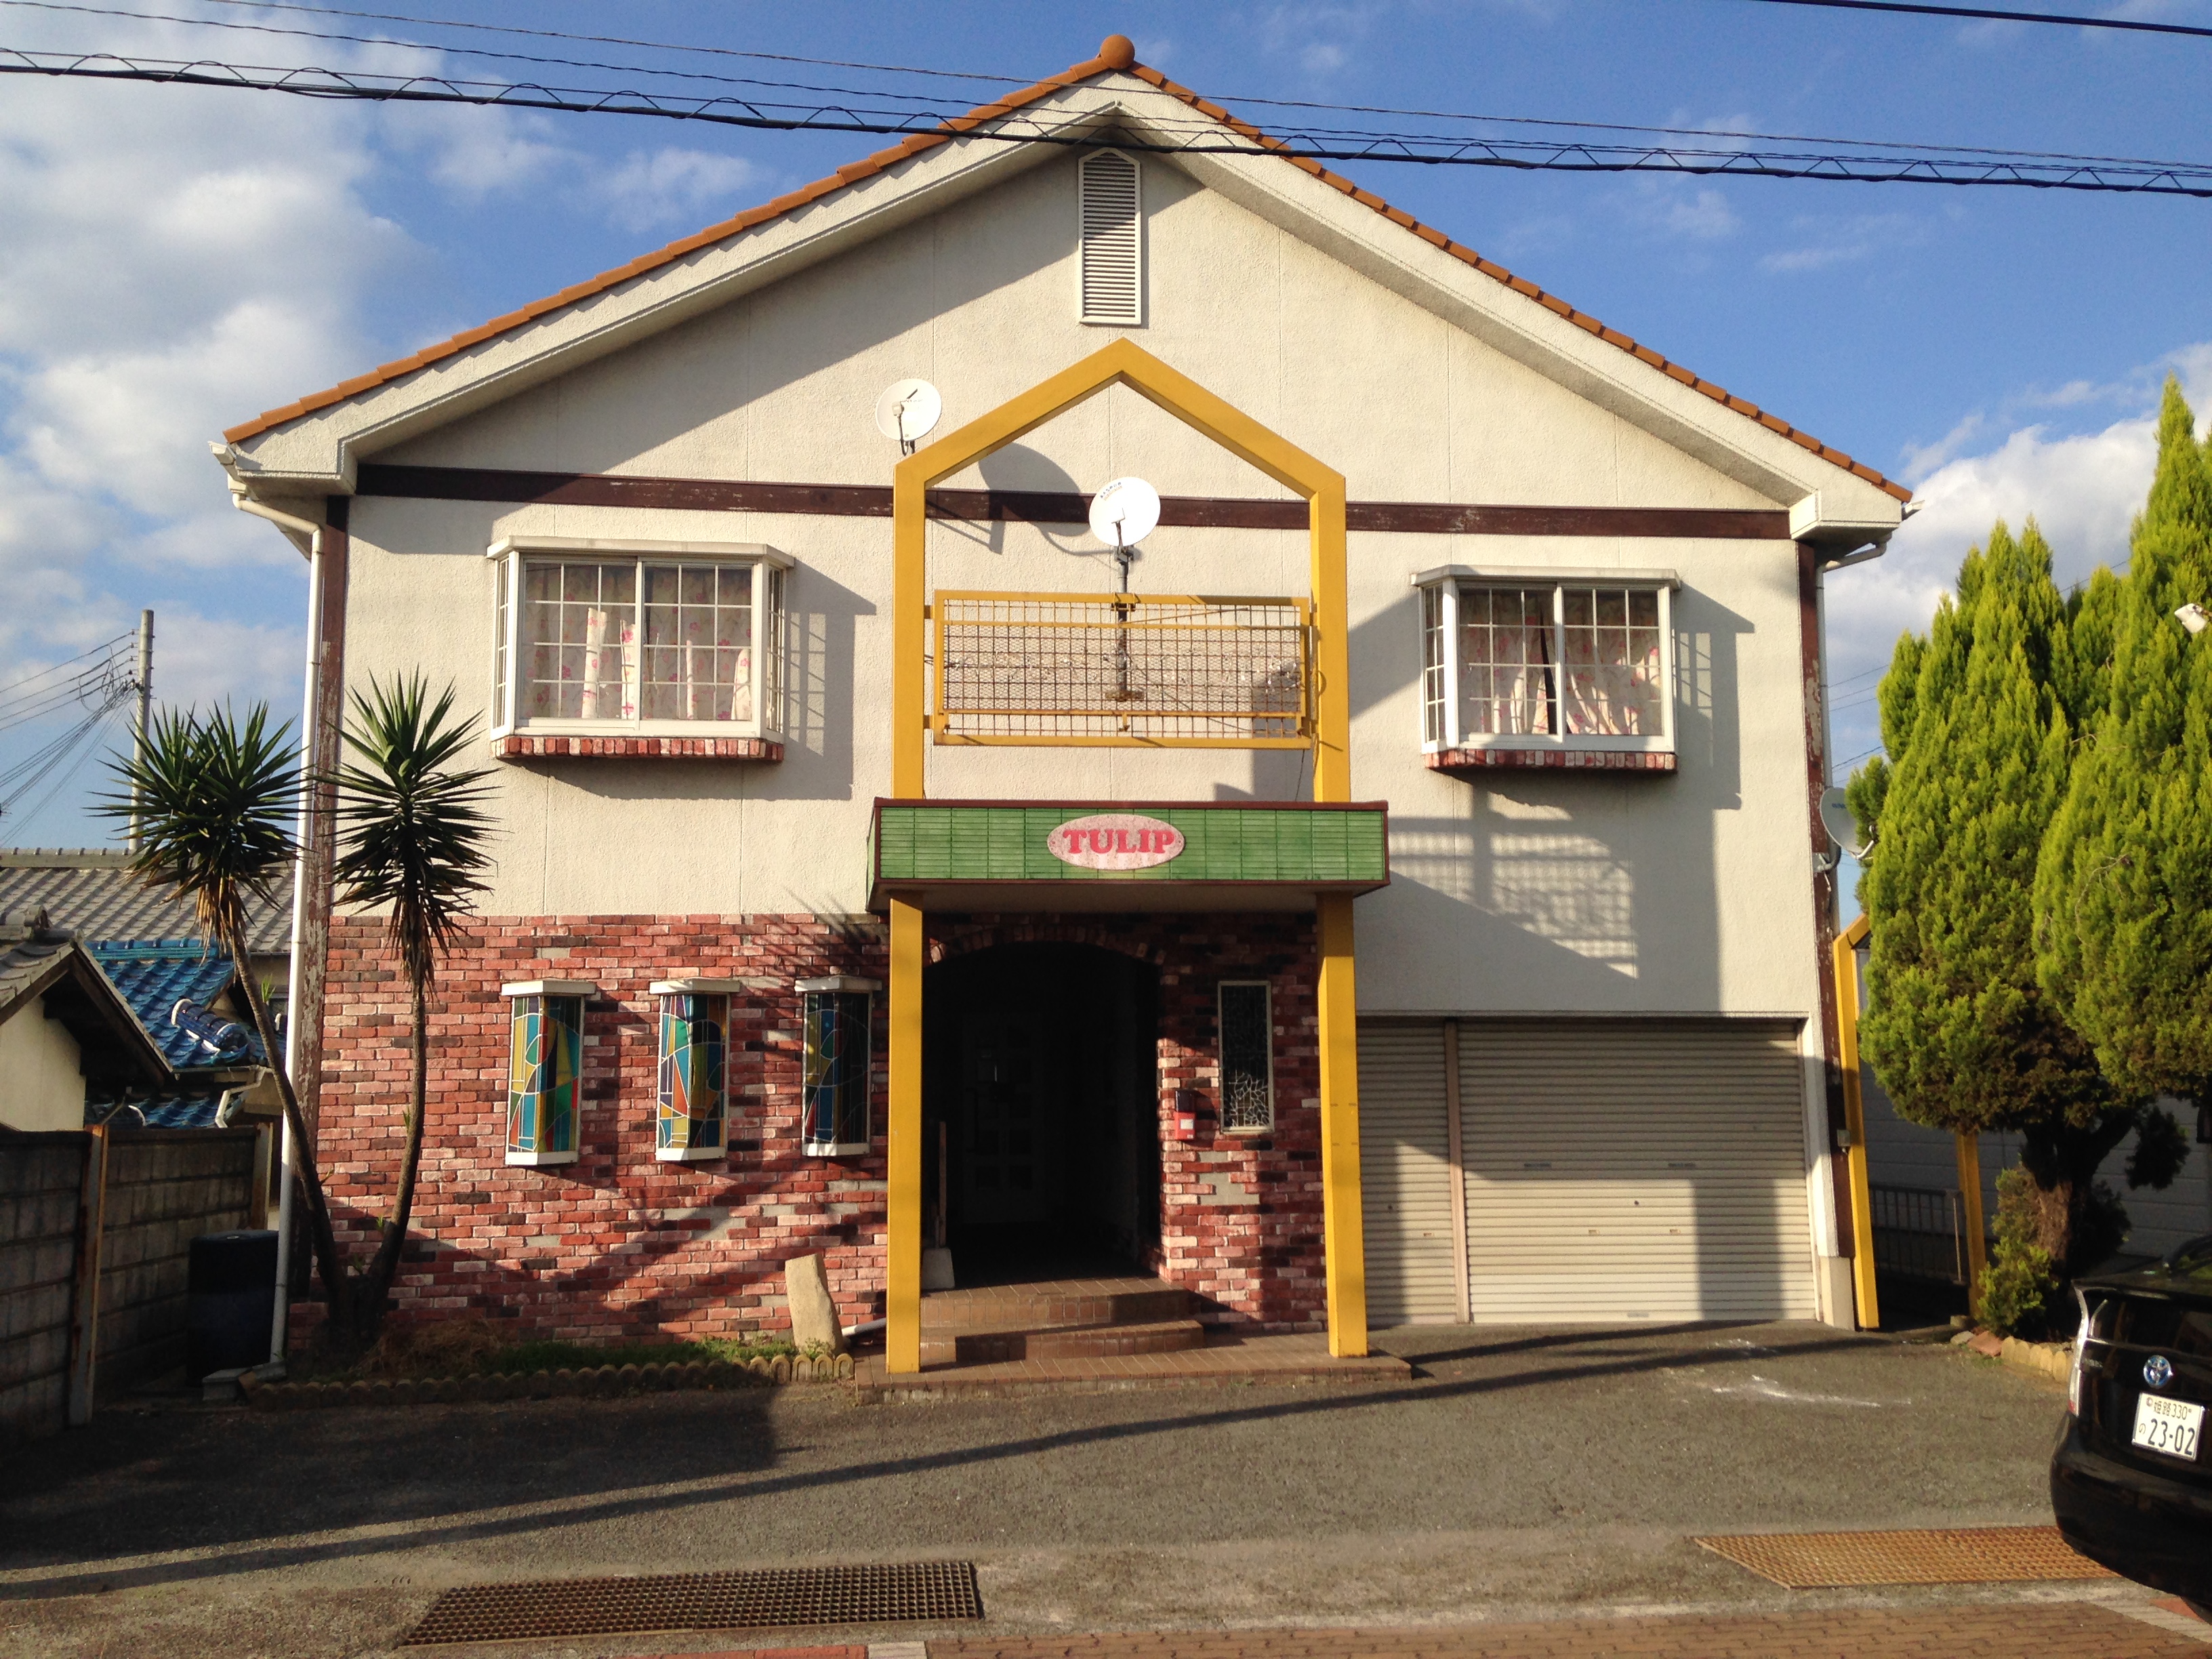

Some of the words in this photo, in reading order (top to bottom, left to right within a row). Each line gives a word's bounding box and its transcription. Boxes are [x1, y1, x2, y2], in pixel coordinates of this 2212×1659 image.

[1063, 829, 1175, 854] TULIP
[2139, 1423, 2146, 1435] の
[2148, 1418, 2196, 1456] 23-02
